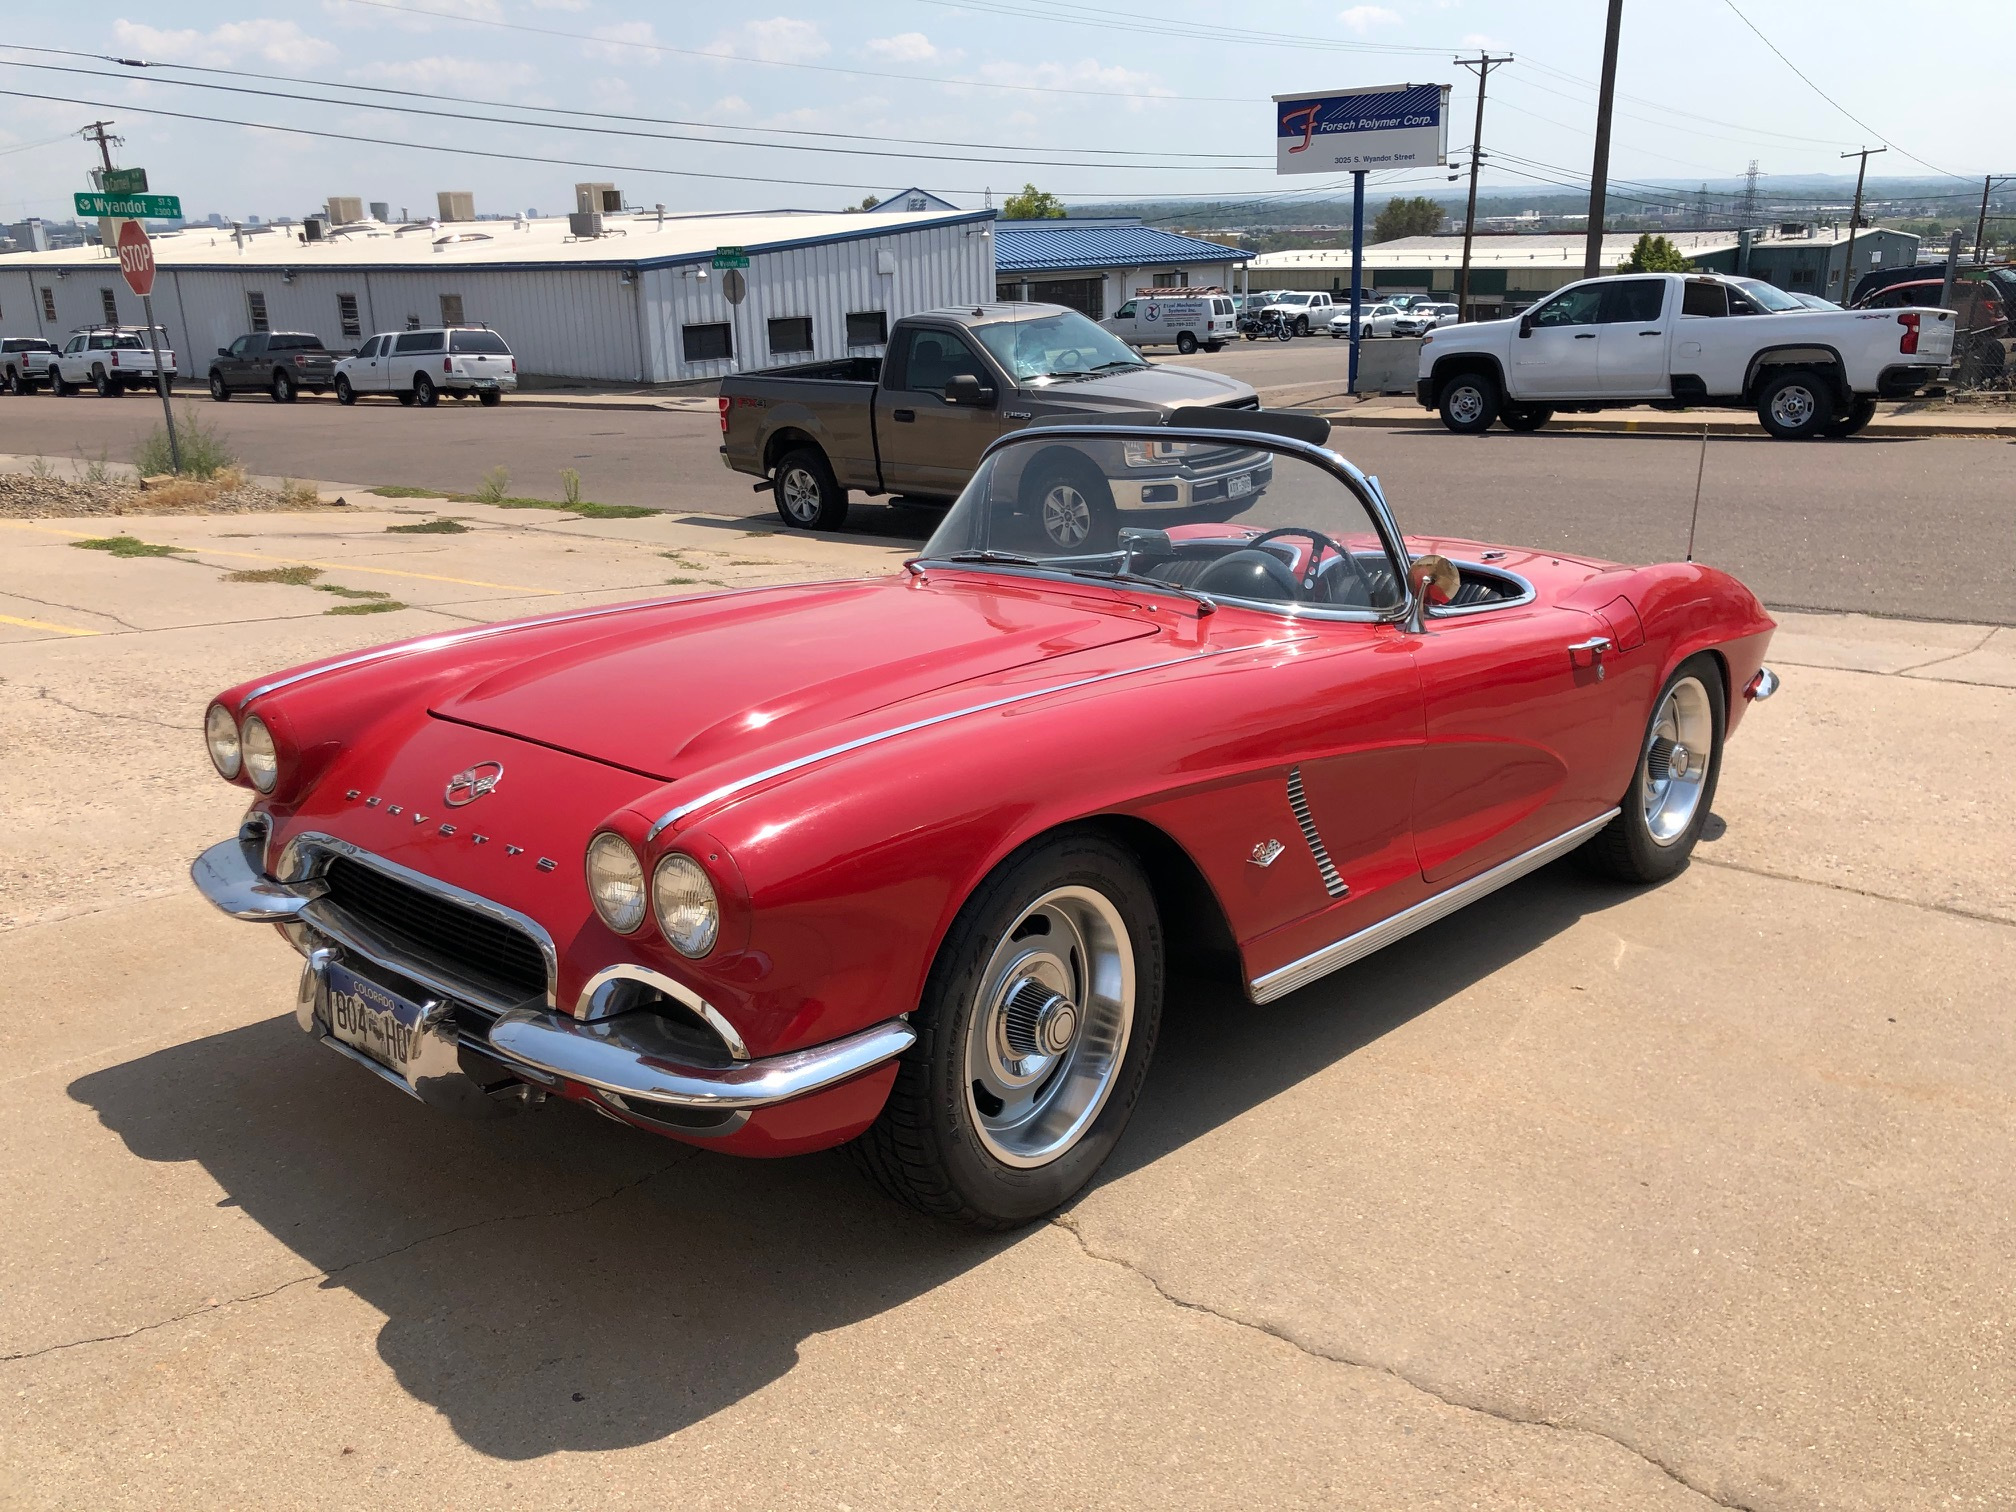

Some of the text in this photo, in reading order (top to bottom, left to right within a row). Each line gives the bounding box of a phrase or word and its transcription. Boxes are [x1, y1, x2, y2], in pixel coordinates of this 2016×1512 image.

[1320, 115, 1432, 132] Forsch Polymer Corp.
[1334, 153, 1415, 164] 3025 S. Wyandot Street
[93, 198, 147, 216] Wyandot
[121, 244, 150, 273] STOP
[354, 982, 395, 1010] COLORADO
